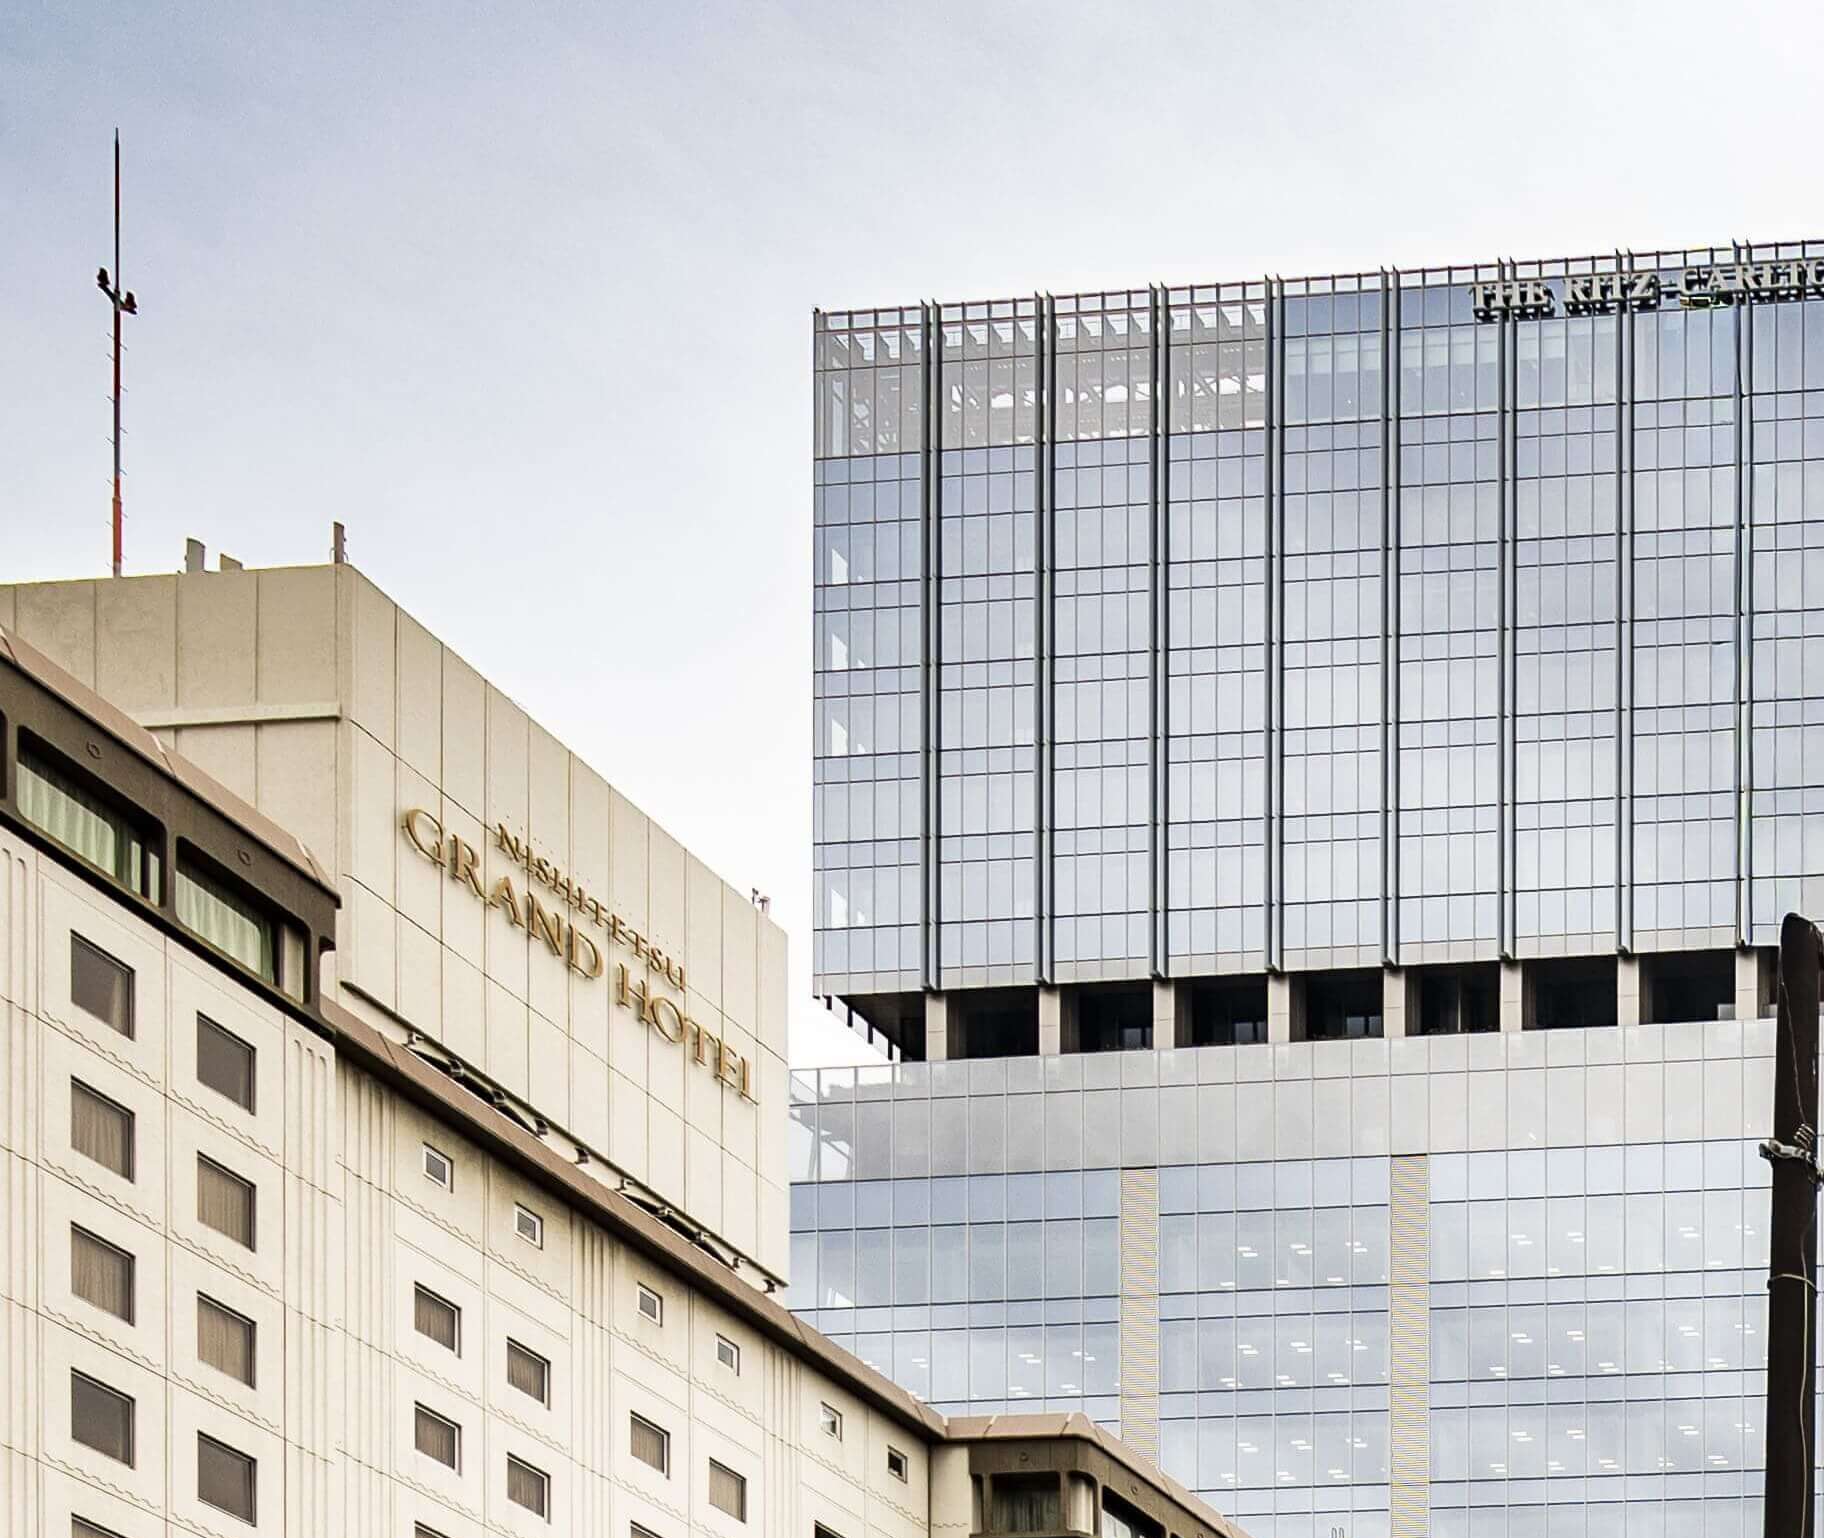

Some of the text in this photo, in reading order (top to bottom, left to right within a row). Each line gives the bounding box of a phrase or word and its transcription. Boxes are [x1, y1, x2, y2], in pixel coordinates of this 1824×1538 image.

[1471, 279, 1552, 312] THE
[402, 807, 760, 1106] GRAND HOTEL
[497, 821, 688, 993] NISHITETSU
